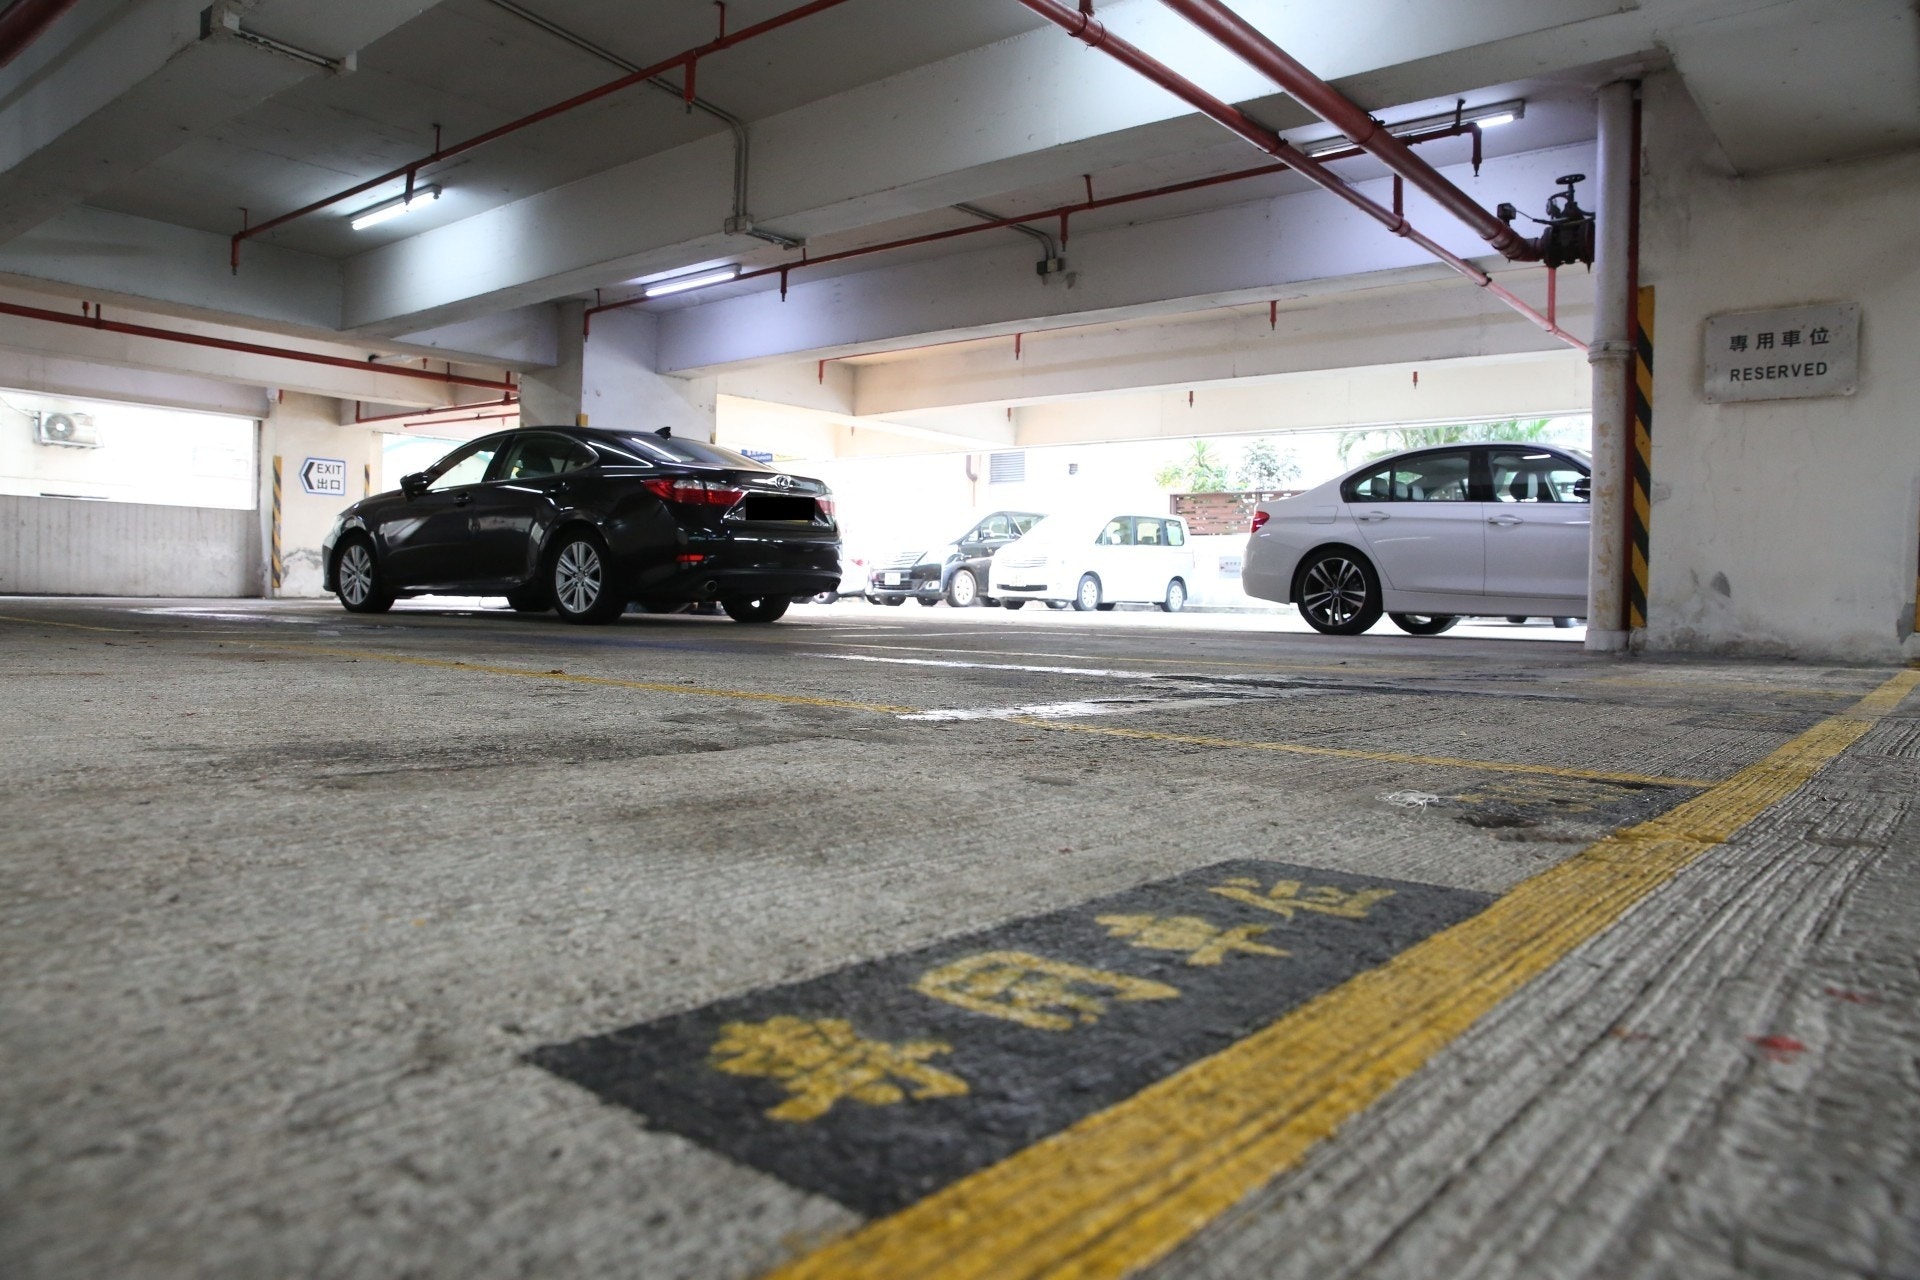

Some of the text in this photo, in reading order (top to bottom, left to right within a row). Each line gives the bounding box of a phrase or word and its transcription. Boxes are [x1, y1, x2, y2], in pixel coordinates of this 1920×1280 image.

[1729, 327, 1830, 352] 專用車位
[1730, 362, 1828, 382] RESERVED
[317, 463, 342, 475] EXIT
[317, 478, 341, 490] 出口
